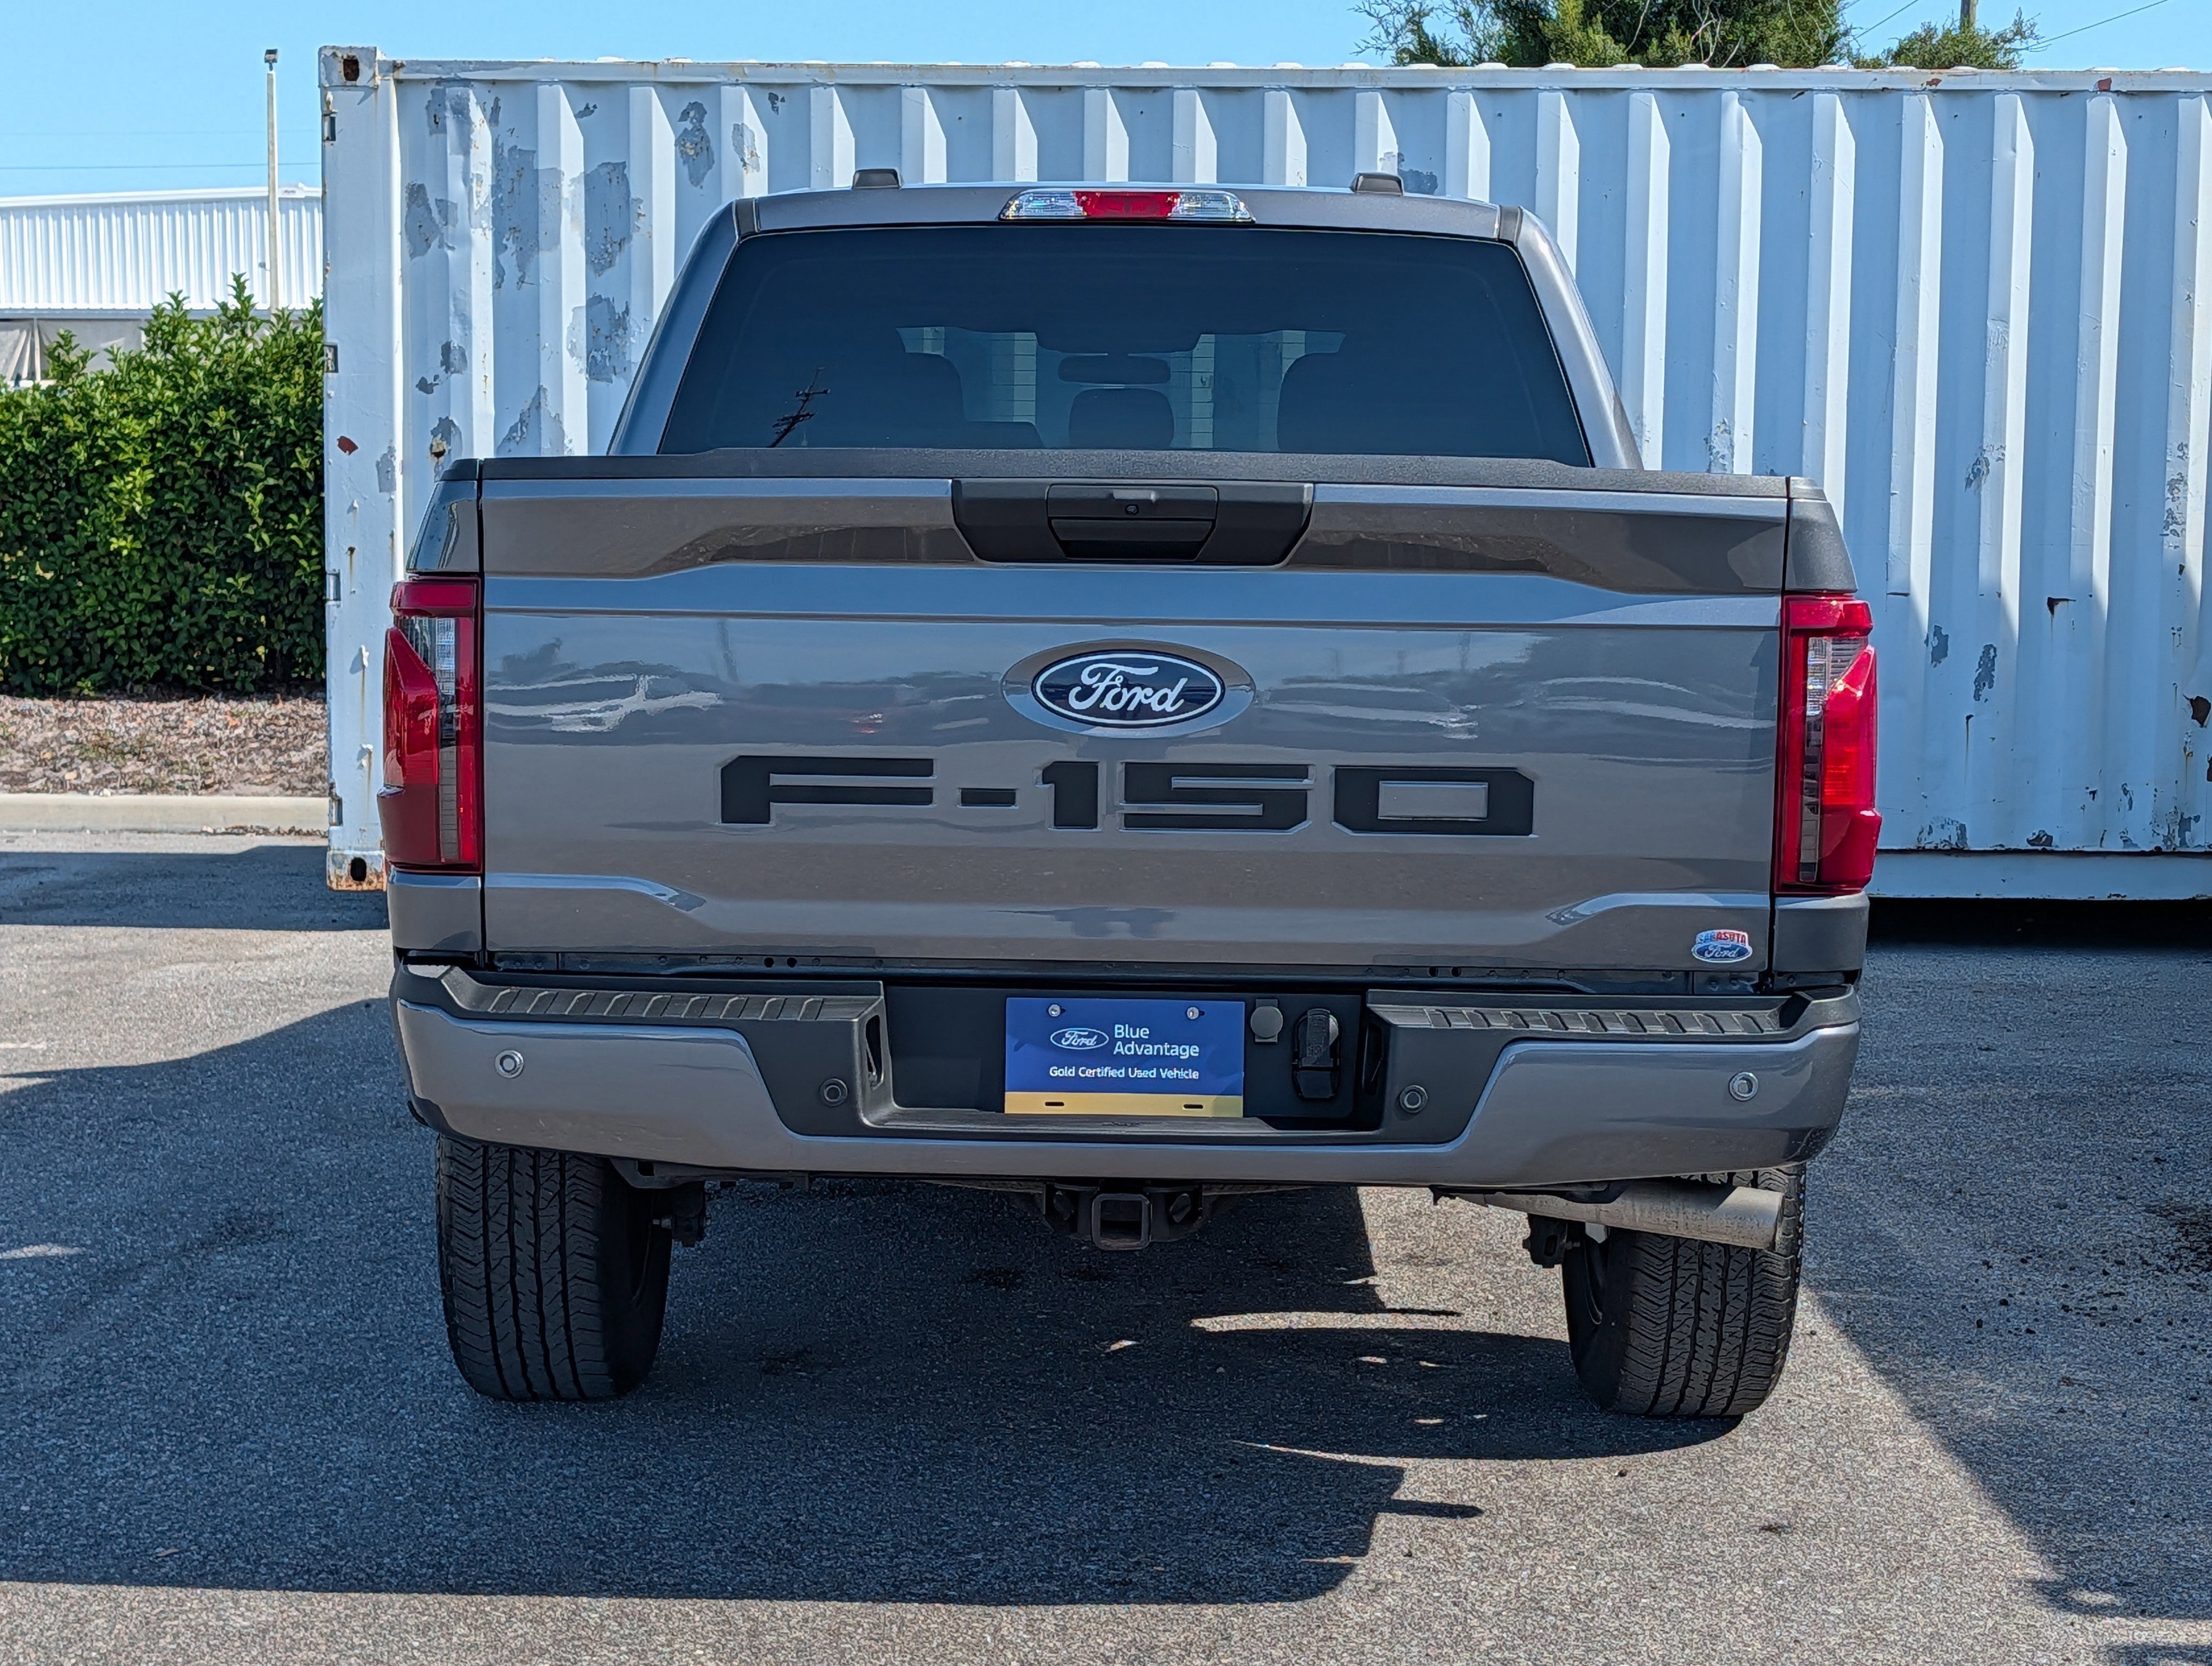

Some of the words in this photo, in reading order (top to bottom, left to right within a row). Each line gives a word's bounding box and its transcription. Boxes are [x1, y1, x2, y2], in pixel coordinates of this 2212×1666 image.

[1069, 663, 1188, 712] Ford
[721, 755, 1535, 836] F-150
[1705, 943, 1739, 958] Ford
[1061, 1030, 1097, 1046] Ford
[1114, 1024, 1149, 1039] Blue
[1113, 1041, 1199, 1059] Advantage
[1050, 1066, 1075, 1077] Gold
[1078, 1066, 1125, 1078] Certified
[1129, 1067, 1156, 1078] Used
[1160, 1068, 1199, 1080] Vehicle
